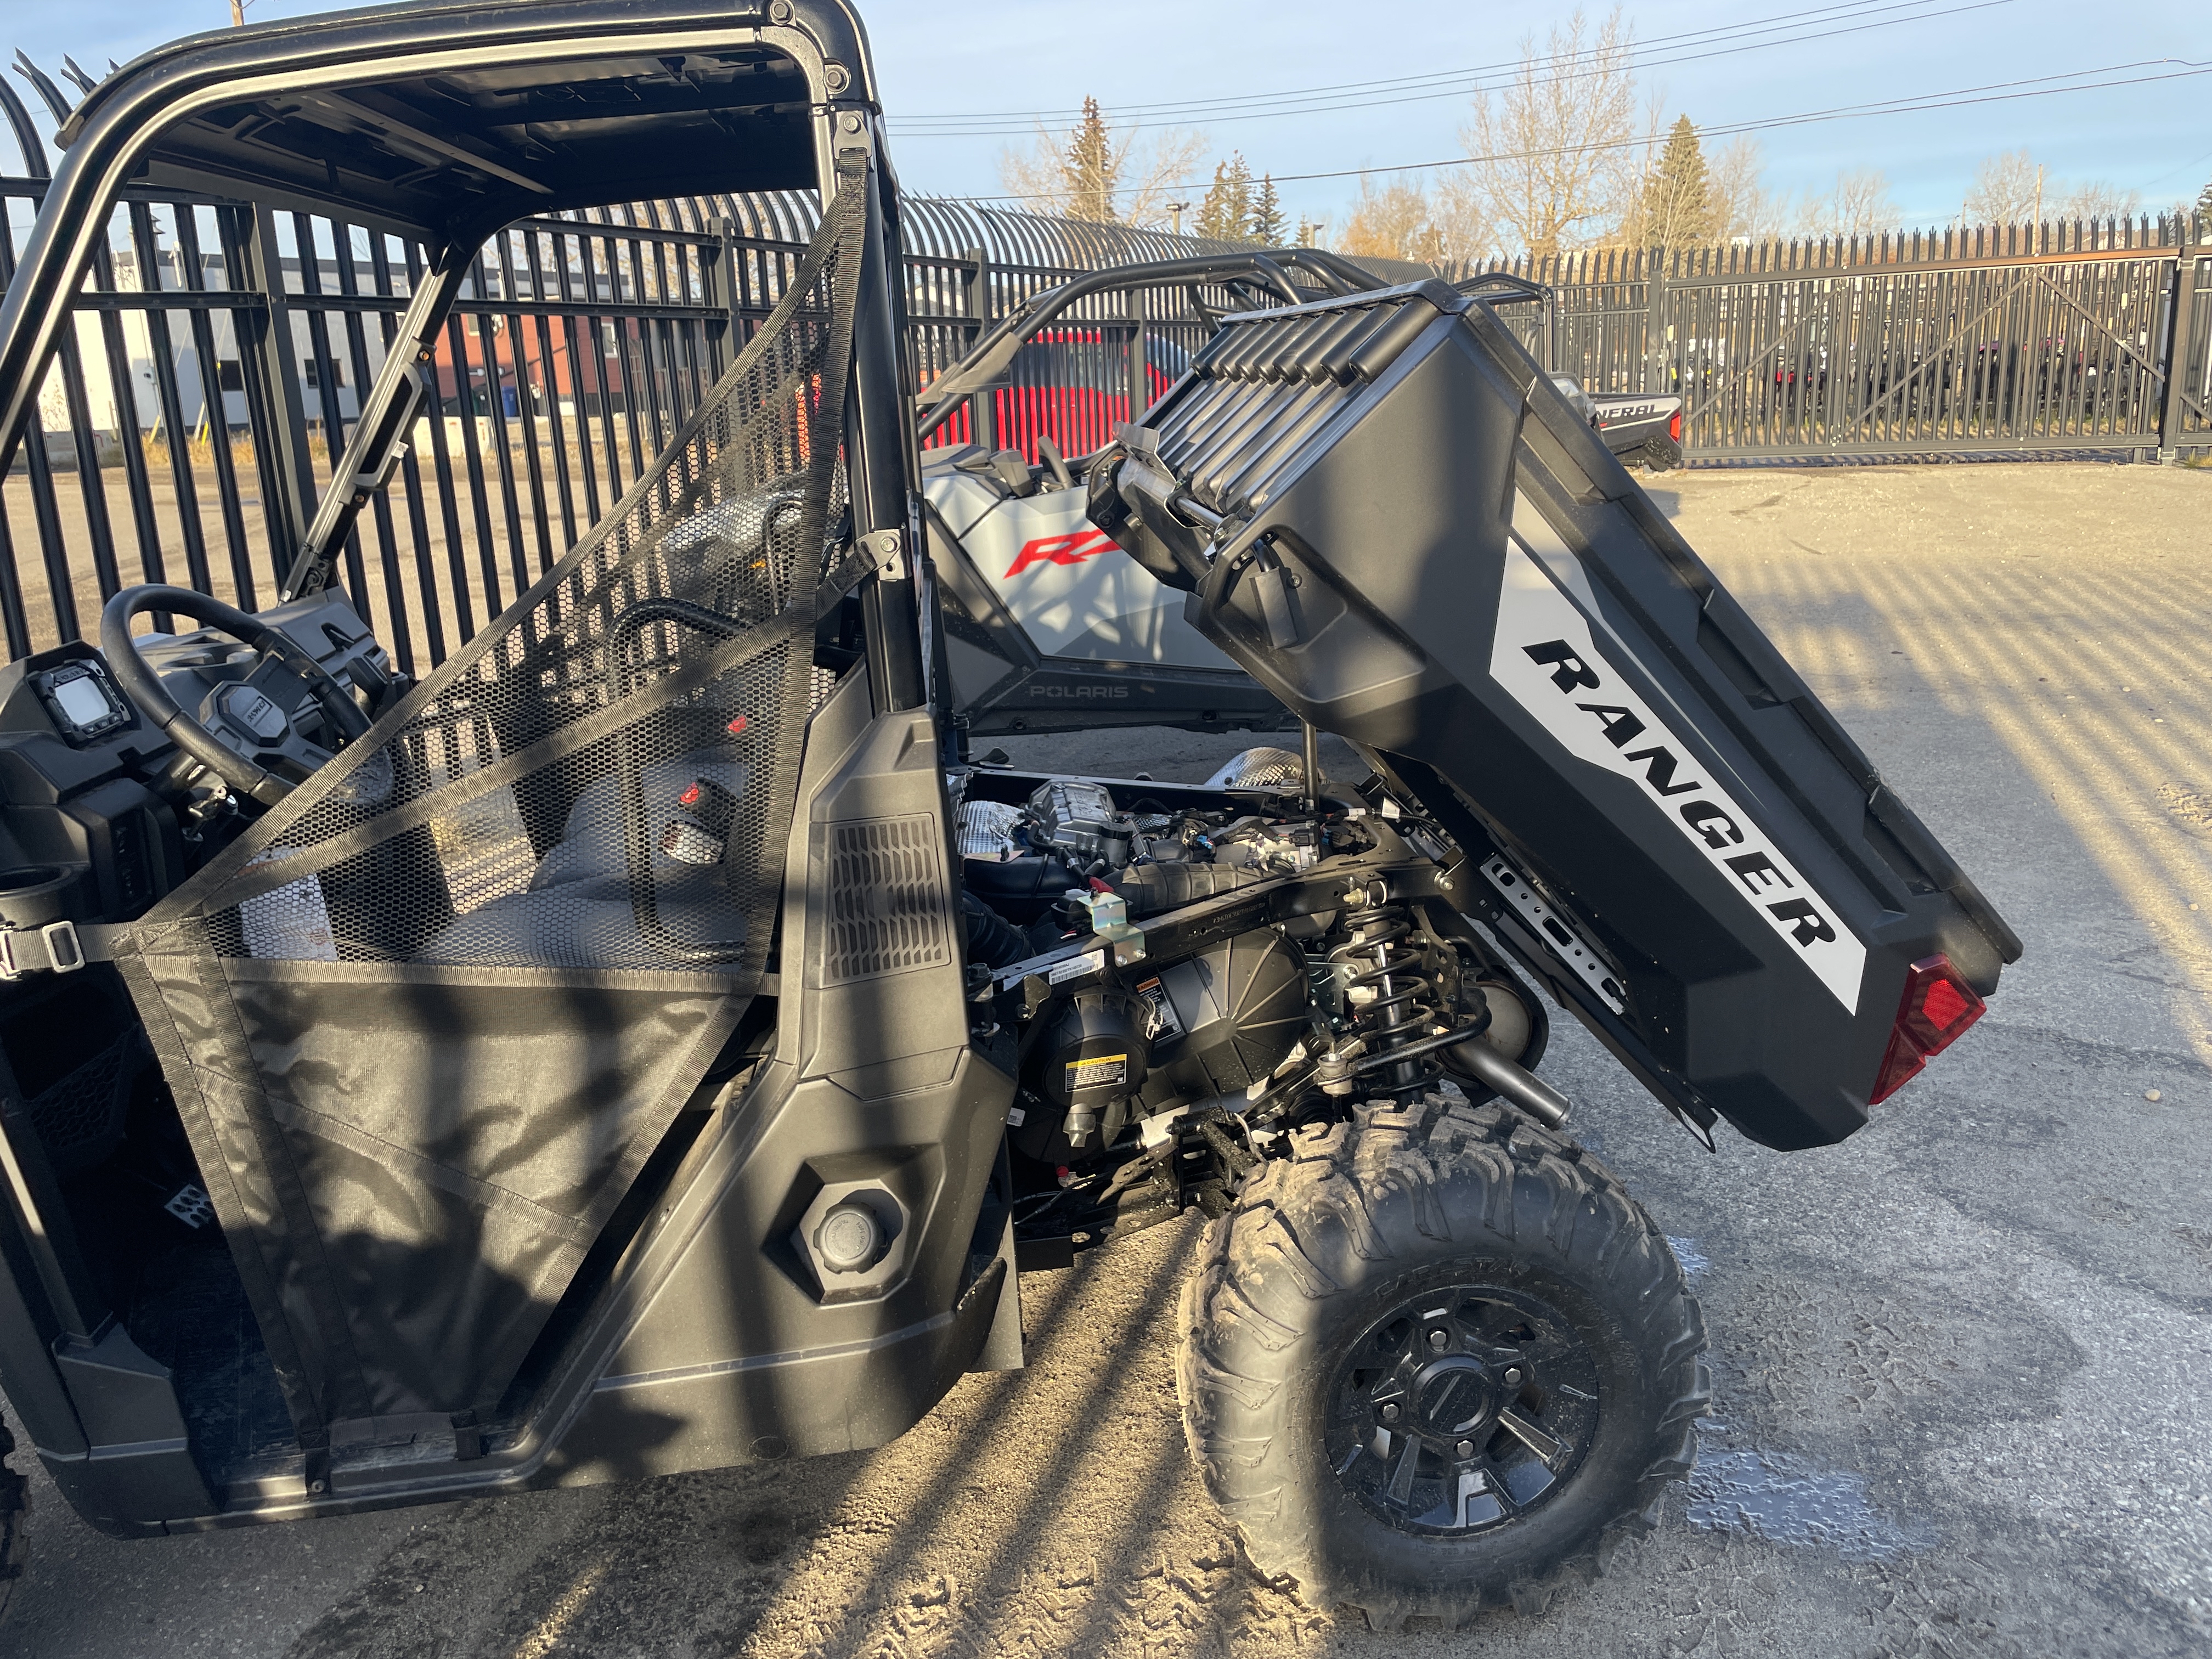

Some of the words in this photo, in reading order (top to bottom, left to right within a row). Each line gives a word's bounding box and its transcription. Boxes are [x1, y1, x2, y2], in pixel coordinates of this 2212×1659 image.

[1596, 404, 1655, 419] NERAL
[1030, 686, 1128, 698] POLARIS
[1521, 639, 1837, 948] RANGER
